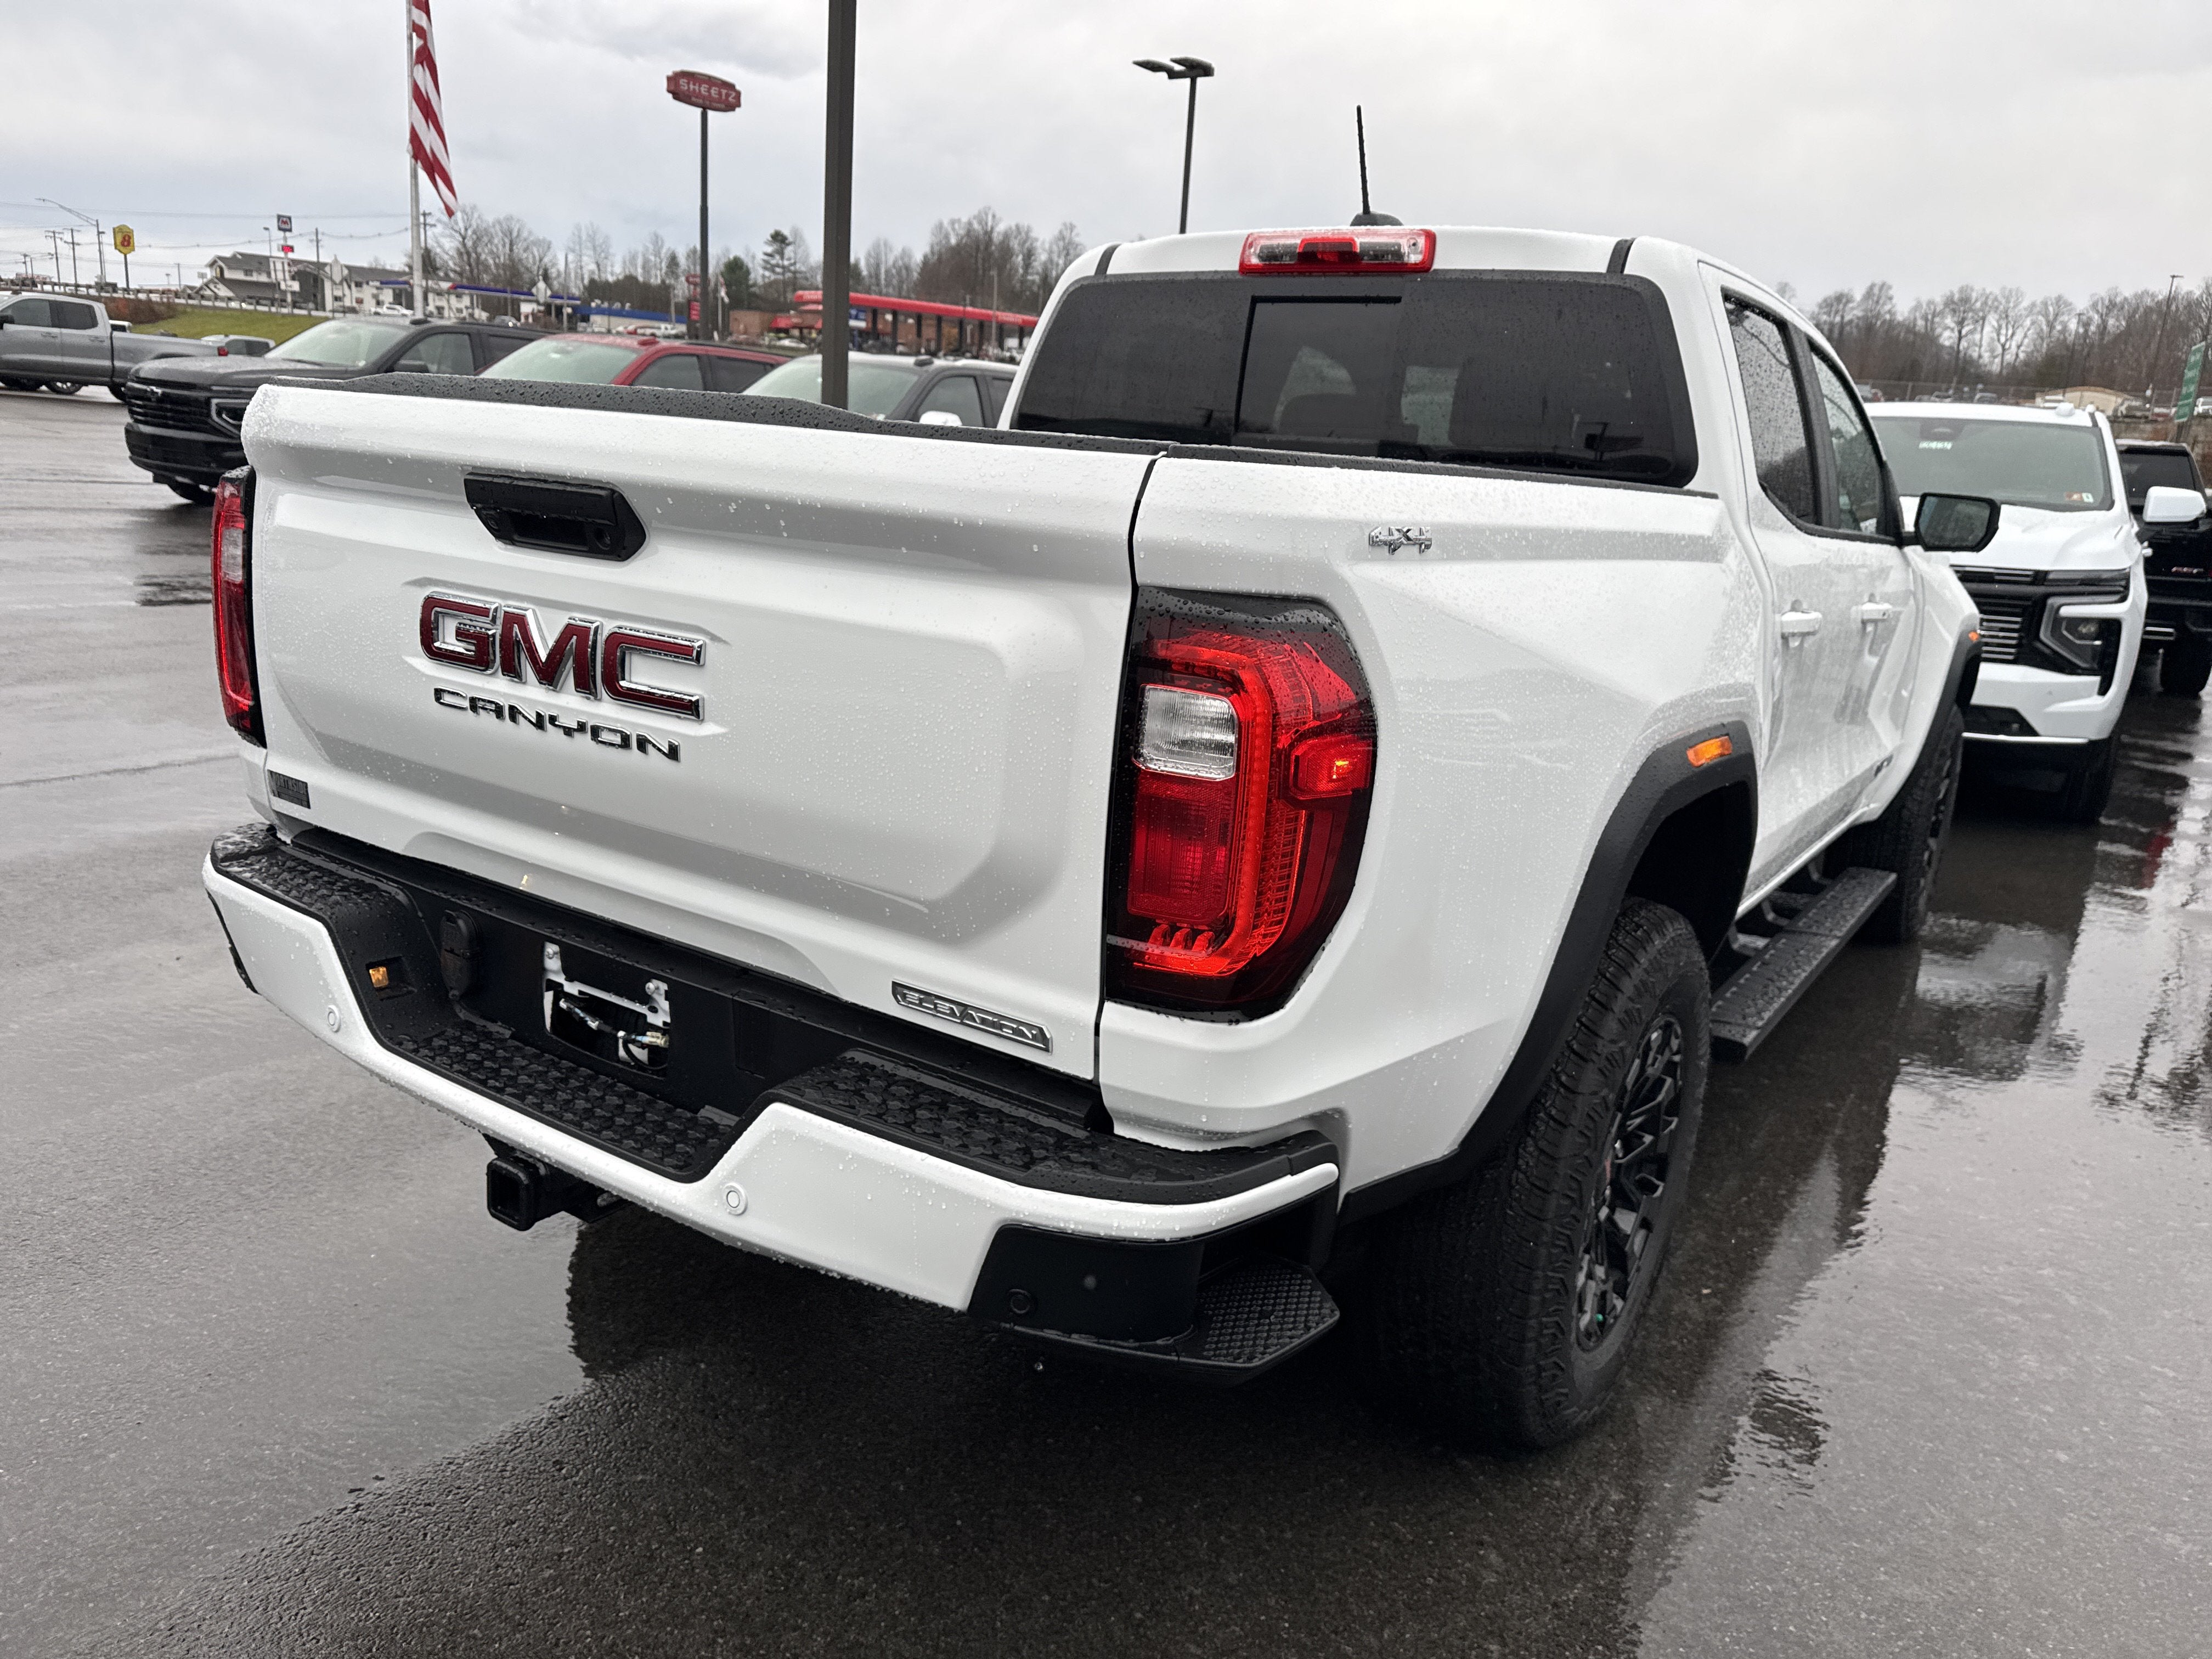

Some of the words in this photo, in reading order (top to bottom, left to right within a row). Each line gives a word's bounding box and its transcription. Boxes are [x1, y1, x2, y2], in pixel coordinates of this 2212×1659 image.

[679, 78, 736, 102] SHEETZ
[121, 234, 131, 247] 8
[420, 591, 706, 720] GMC
[434, 686, 680, 762] CANYON
[903, 990, 1037, 1039] ELEVATION
